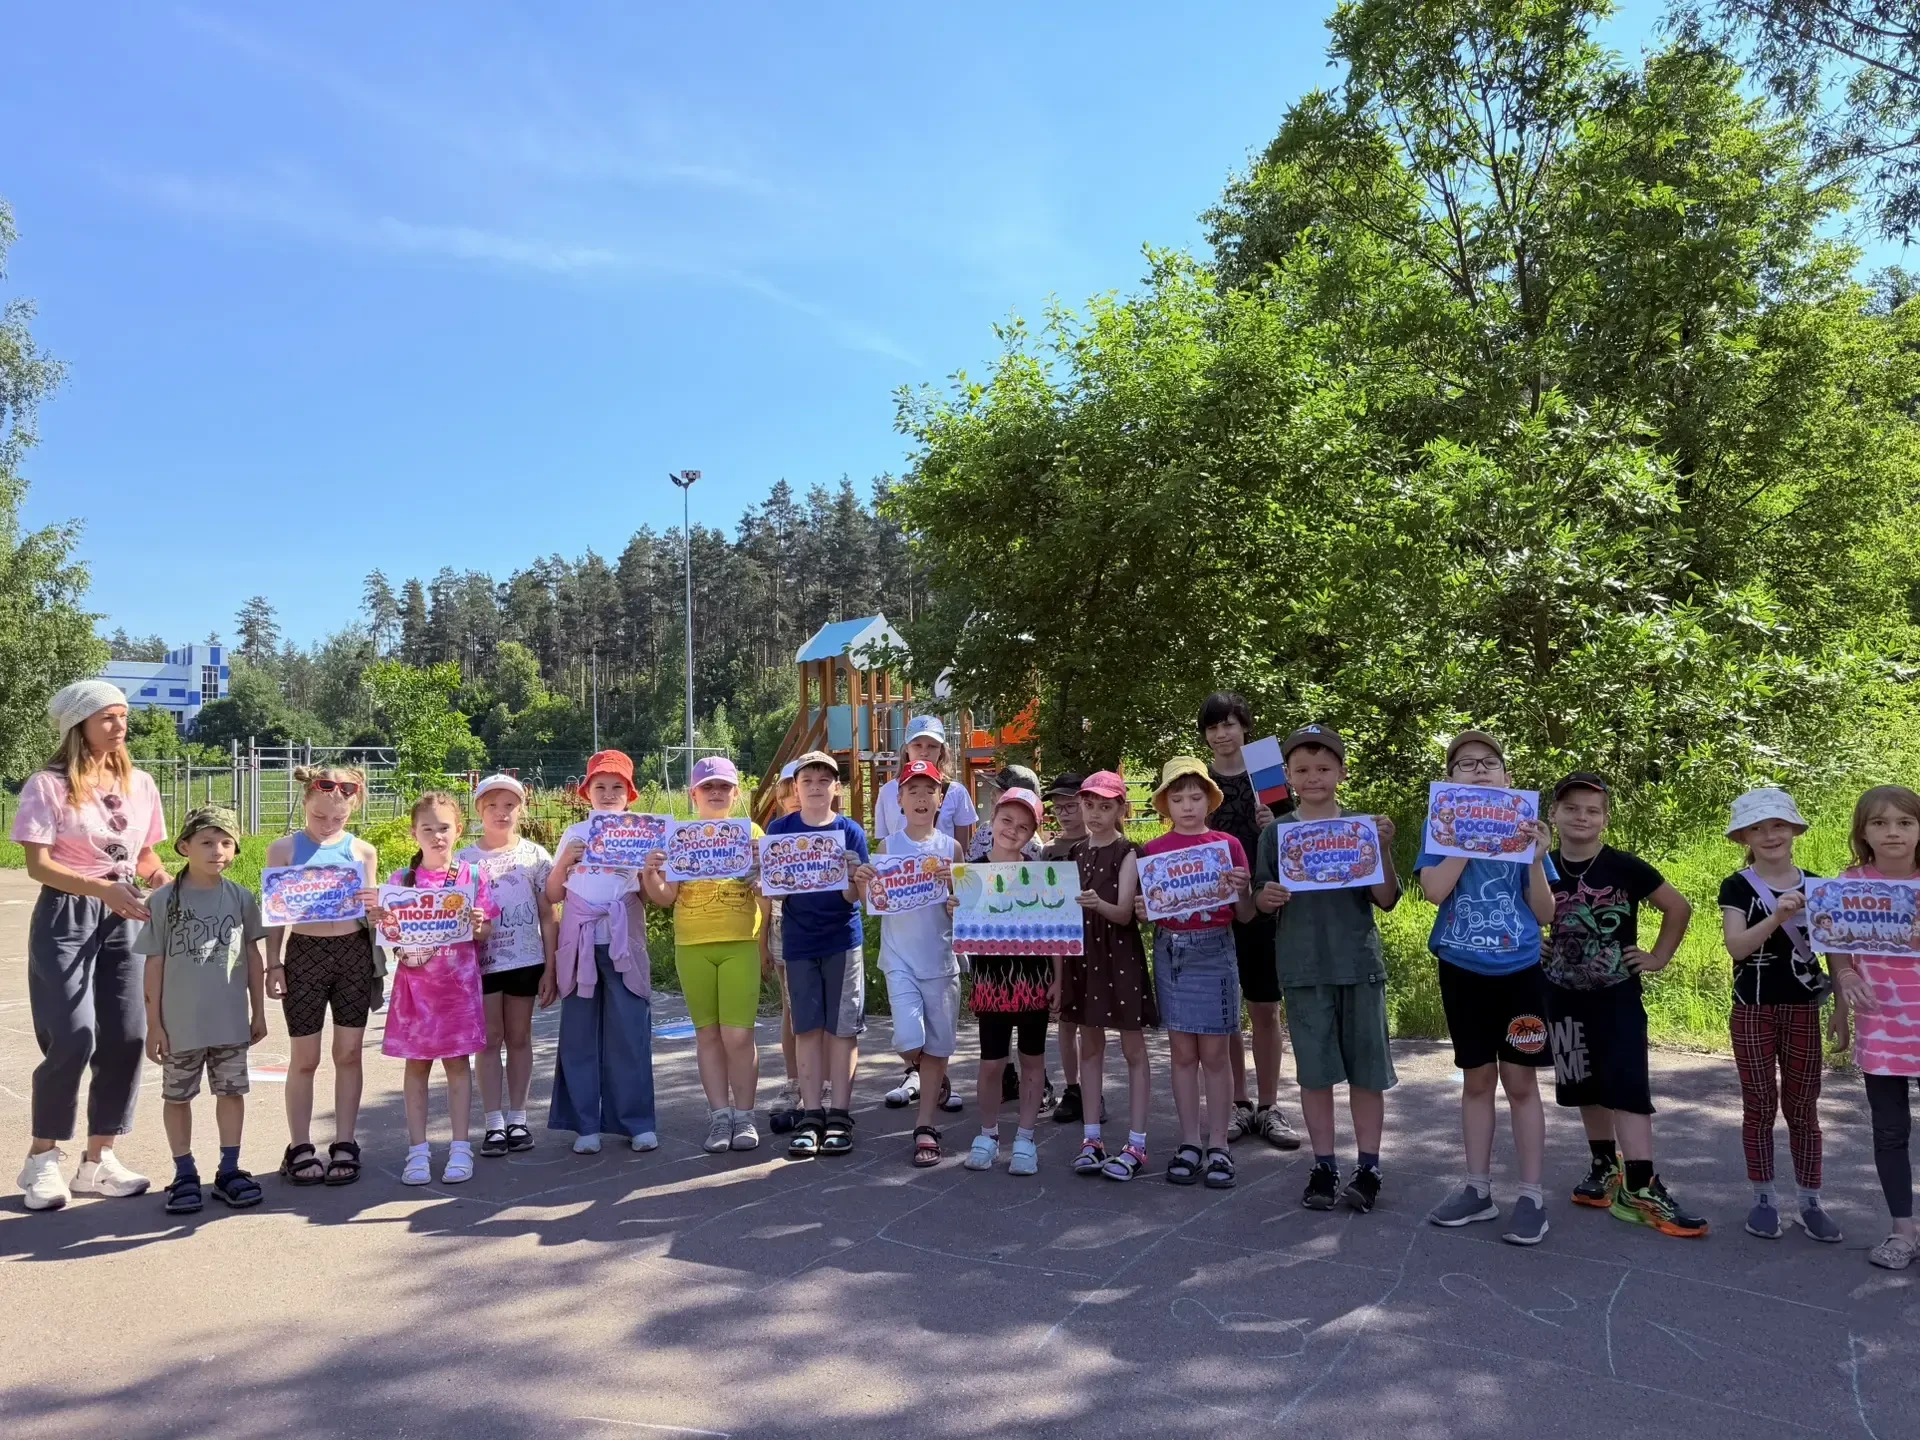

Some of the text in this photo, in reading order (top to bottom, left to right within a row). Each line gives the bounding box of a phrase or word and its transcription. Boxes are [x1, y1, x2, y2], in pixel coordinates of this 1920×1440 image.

[1455, 805, 1517, 823] С ДНЁМ
[608, 829, 655, 839] ГОРЖУСЬ
[1455, 819, 1516, 836] РОССИИ!
[605, 839, 656, 848] РОССИЕЙ!
[1301, 835, 1358, 852] С ДНЁМ
[688, 847, 737, 860] ЭТО МЫ!
[1303, 851, 1359, 867] РОССИИ!
[783, 860, 831, 874] ЭТО МЫ!
[903, 859, 915, 874] Я
[1167, 860, 1204, 878] МОЯ
[287, 881, 344, 893] ГОРЖУСЬ
[885, 871, 932, 888] ЛЮБЛЮ
[1160, 871, 1219, 892] РОДИНА
[285, 889, 346, 904] РОССИЕЙ!
[887, 882, 934, 899] РОССИЮ
[420, 894, 434, 909] Я
[1841, 896, 1892, 910] МОЯ
[398, 909, 457, 920] ЛЮБЛЮ
[1831, 910, 1912, 925] РОДИНА
[401, 920, 458, 932] РОССИЮ
[169, 914, 237, 957] EPIC
